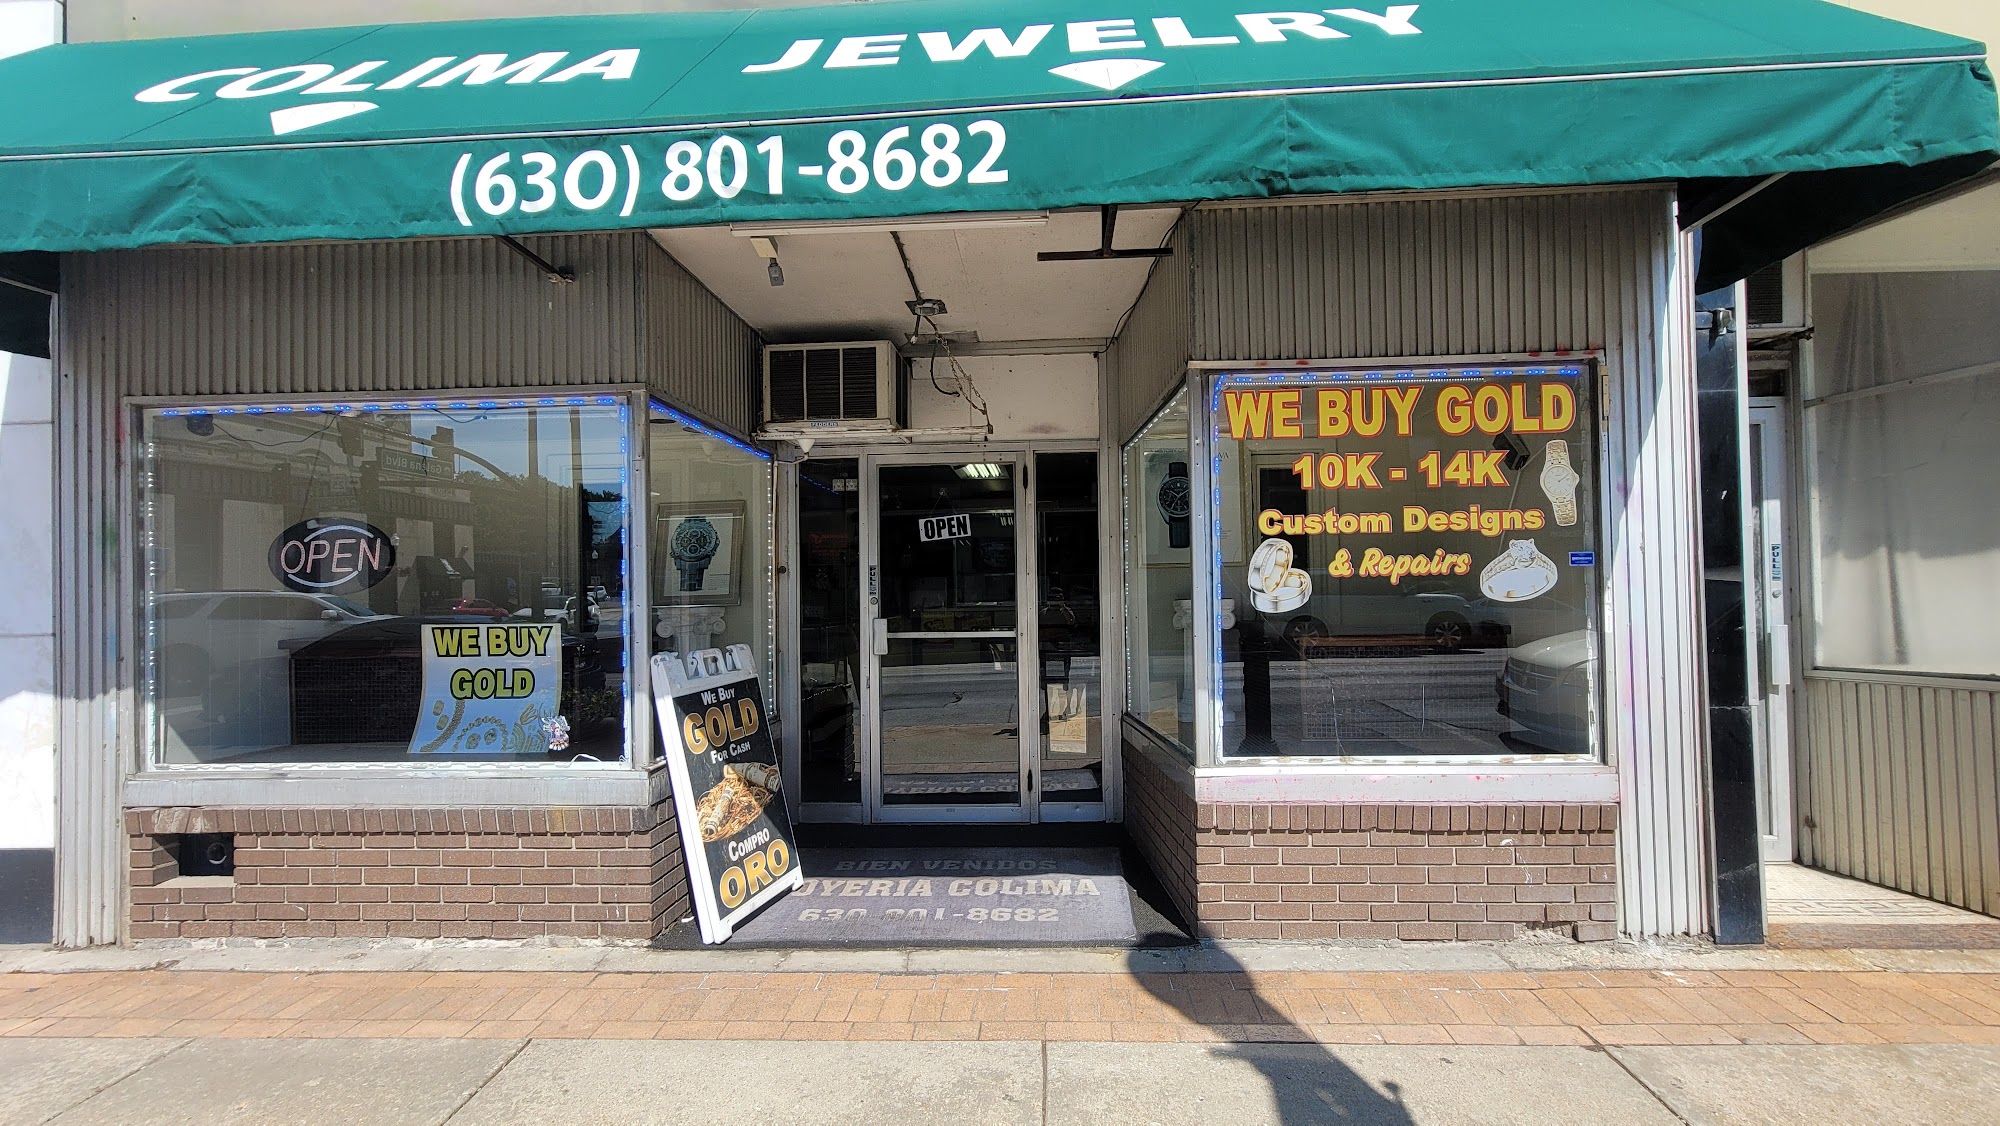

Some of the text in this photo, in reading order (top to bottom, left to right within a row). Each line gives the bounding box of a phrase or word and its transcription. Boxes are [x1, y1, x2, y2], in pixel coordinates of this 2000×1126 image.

[134, 4, 1423, 103] COLIMA JEWELRY
[449, 119, 1010, 227] (630) 801-8682
[1223, 382, 1577, 440] WE BUY GOLD
[1292, 451, 1384, 490] 10K
[1418, 449, 1511, 488] 14K
[923, 515, 969, 540] OPEN
[1257, 506, 1393, 537] Custom
[1402, 504, 1546, 538] Designs
[280, 537, 382, 574] OPEN
[1328, 547, 1471, 586] & Repairs
[1771, 546, 1780, 569] PULL
[431, 625, 554, 658] WE BUY
[450, 667, 536, 700] GOLD
[683, 697, 760, 755] GOLD
[719, 838, 790, 909] ORO
[834, 859, 1057, 871] BIEN VENIDOS
[791, 878, 1101, 897] OYERIA COLIMA
